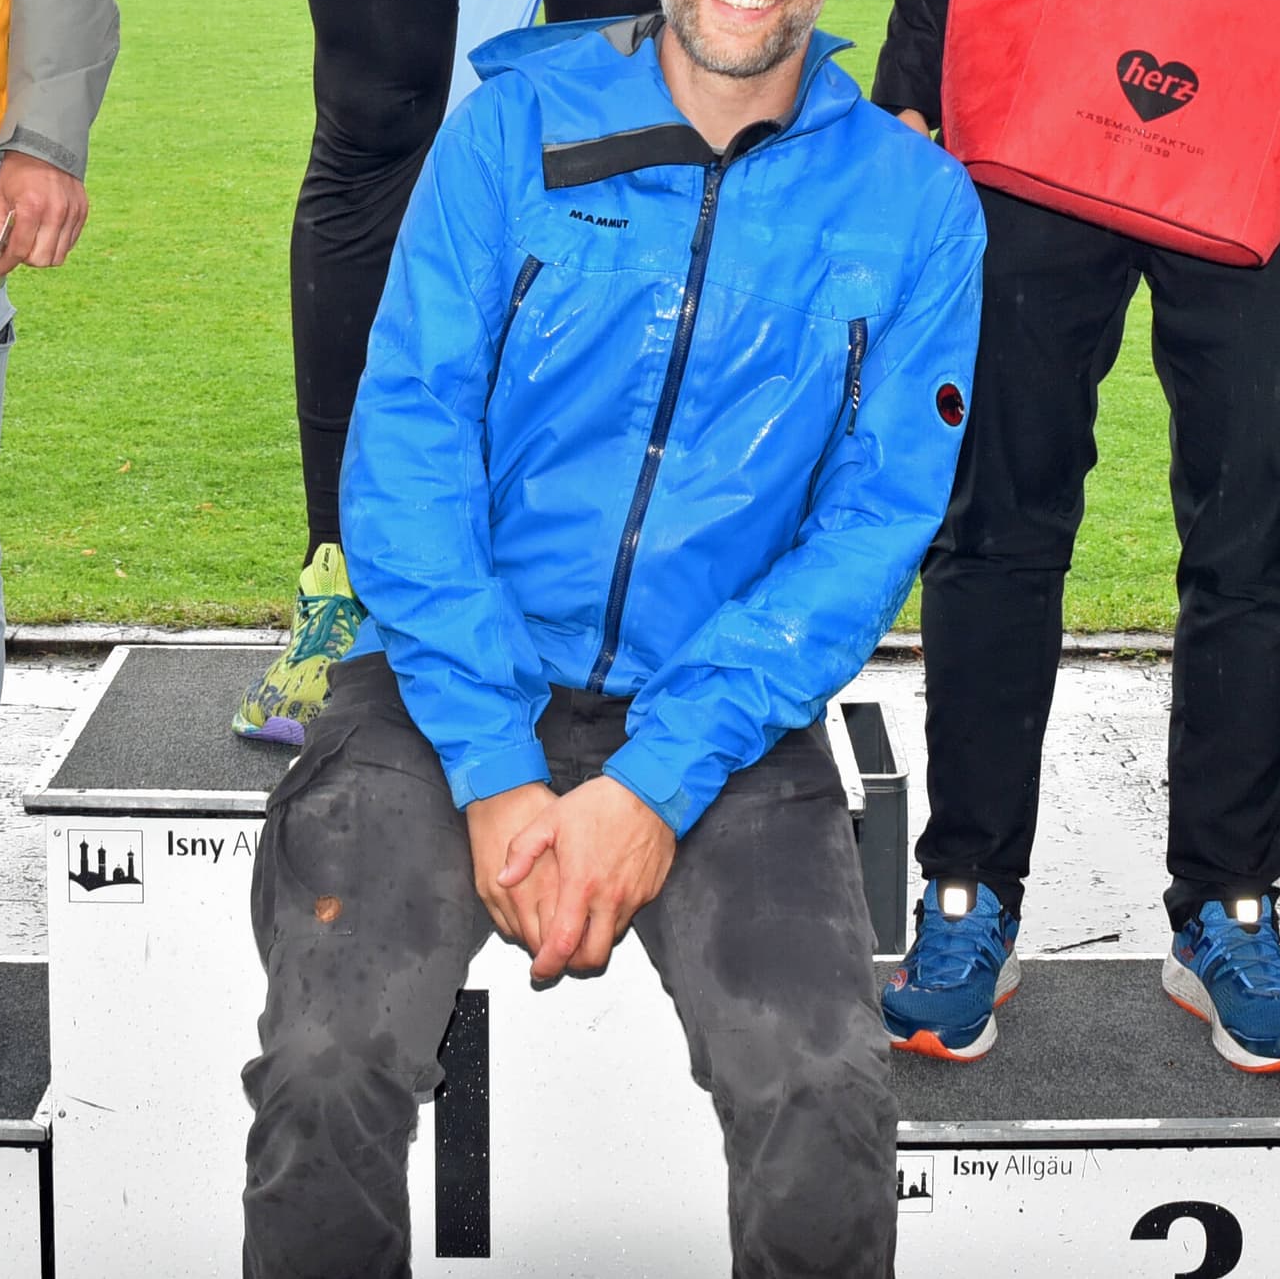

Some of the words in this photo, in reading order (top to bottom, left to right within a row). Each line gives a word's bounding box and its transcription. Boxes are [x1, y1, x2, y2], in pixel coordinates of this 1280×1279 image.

[1122, 56, 1198, 101] herz
[569, 209, 630, 229] MAMMUT
[168, 830, 225, 864] Isny
[233, 831, 258, 857] Al
[953, 1155, 999, 1182] Isny
[1004, 1154, 1073, 1181] Allgäu
